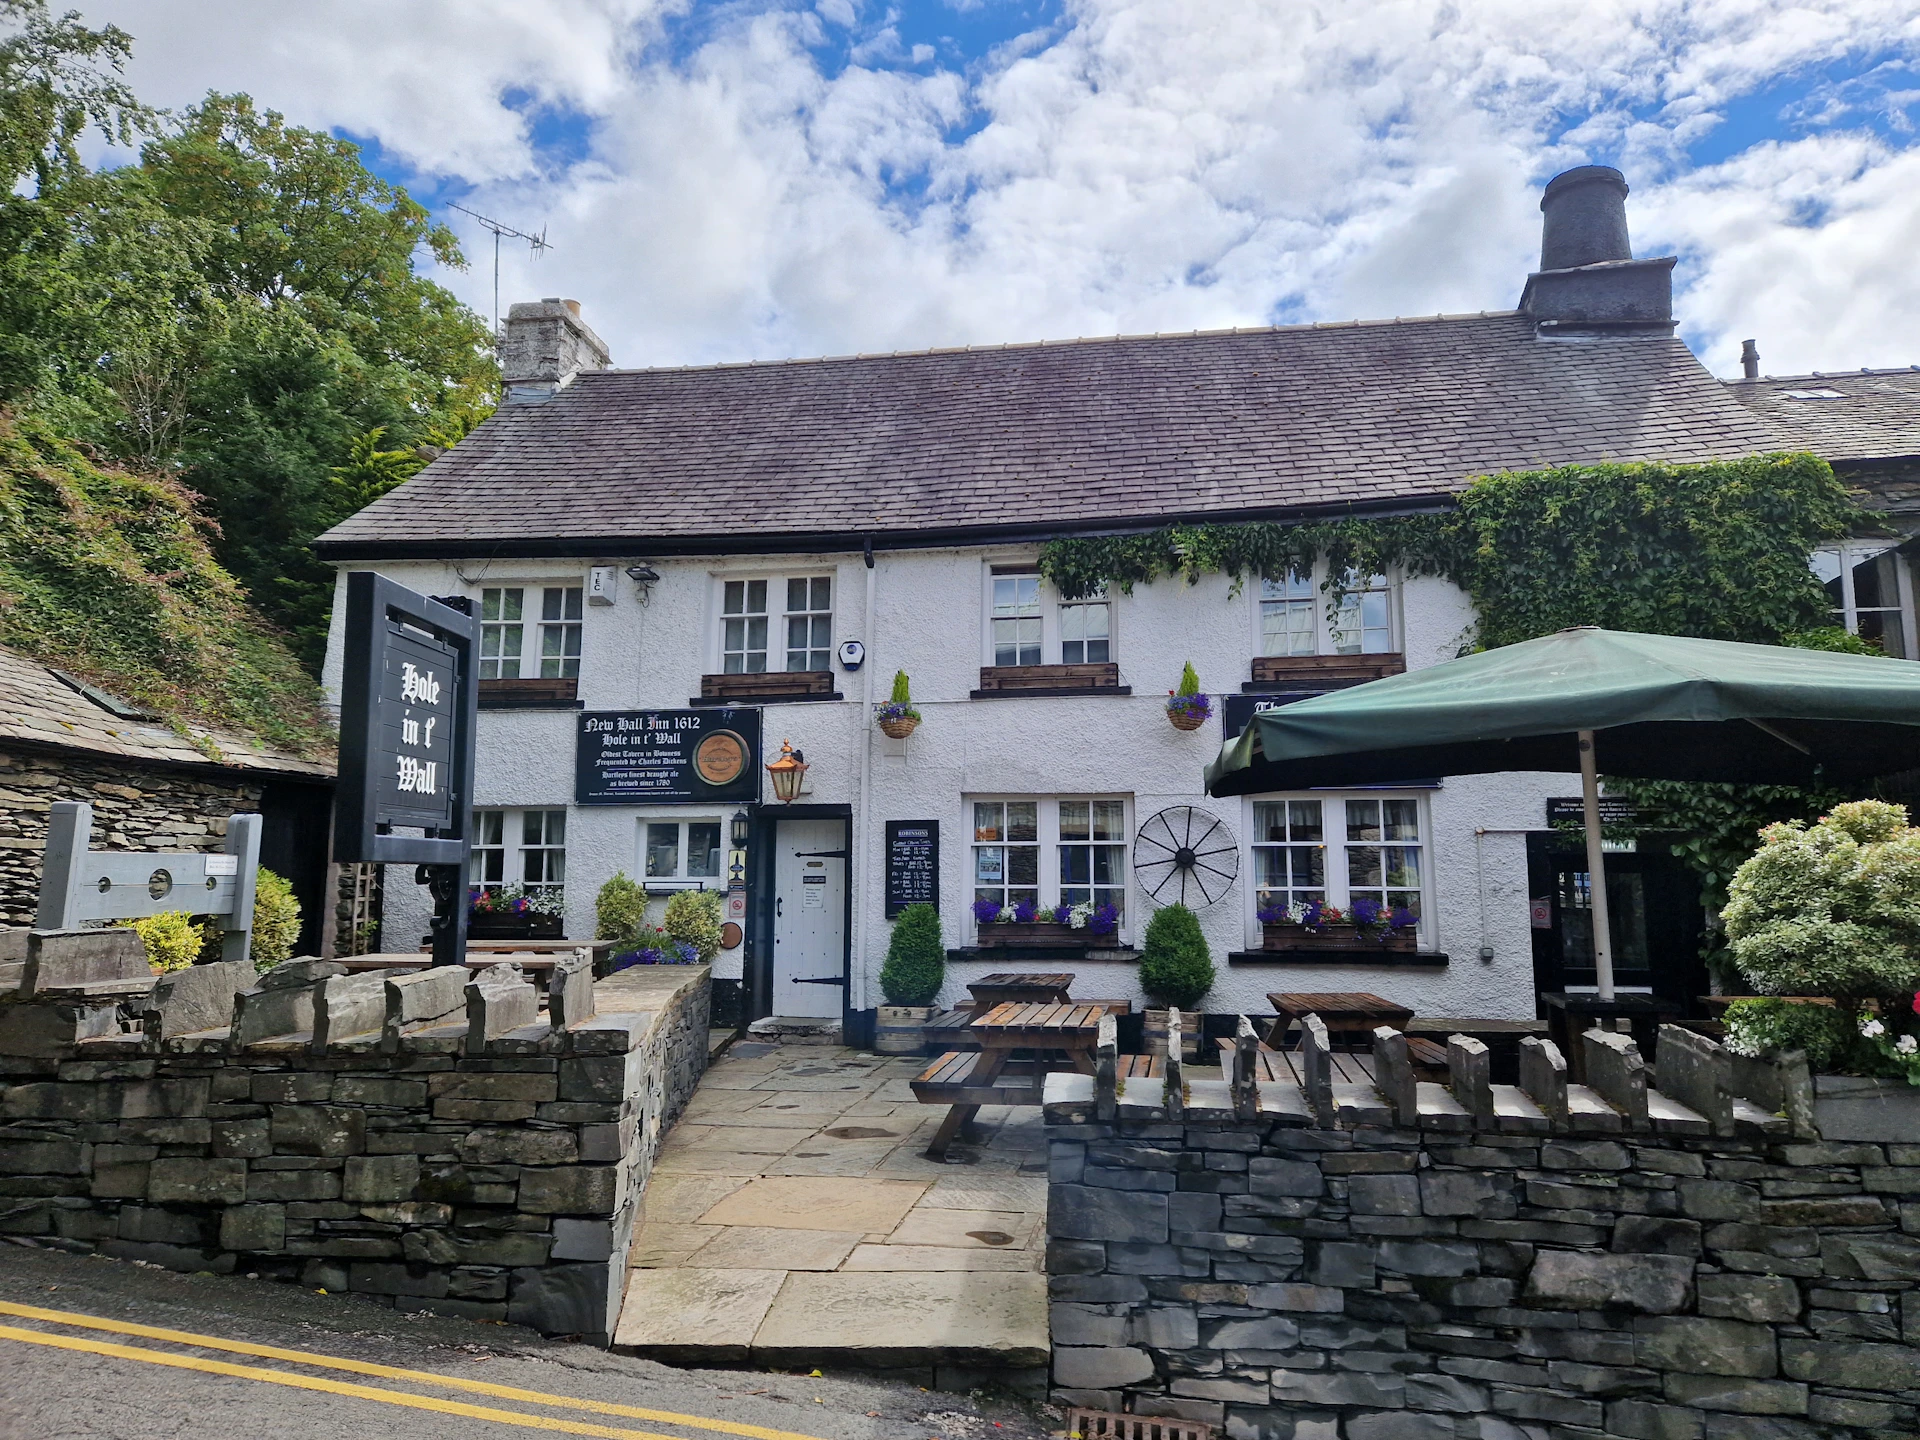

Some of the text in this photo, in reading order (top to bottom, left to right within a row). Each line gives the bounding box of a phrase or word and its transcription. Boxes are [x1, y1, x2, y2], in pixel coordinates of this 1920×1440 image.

[401, 662, 440, 705] Hole
[402, 709, 419, 746] in
[584, 716, 700, 732] New Hall Inn 1612
[602, 733, 628, 747] Hole
[631, 733, 640, 745] in
[655, 732, 681, 744] Wall
[638, 758, 661, 766] Charles
[397, 755, 436, 795] Wall
[602, 771, 628, 779] Hartleys
